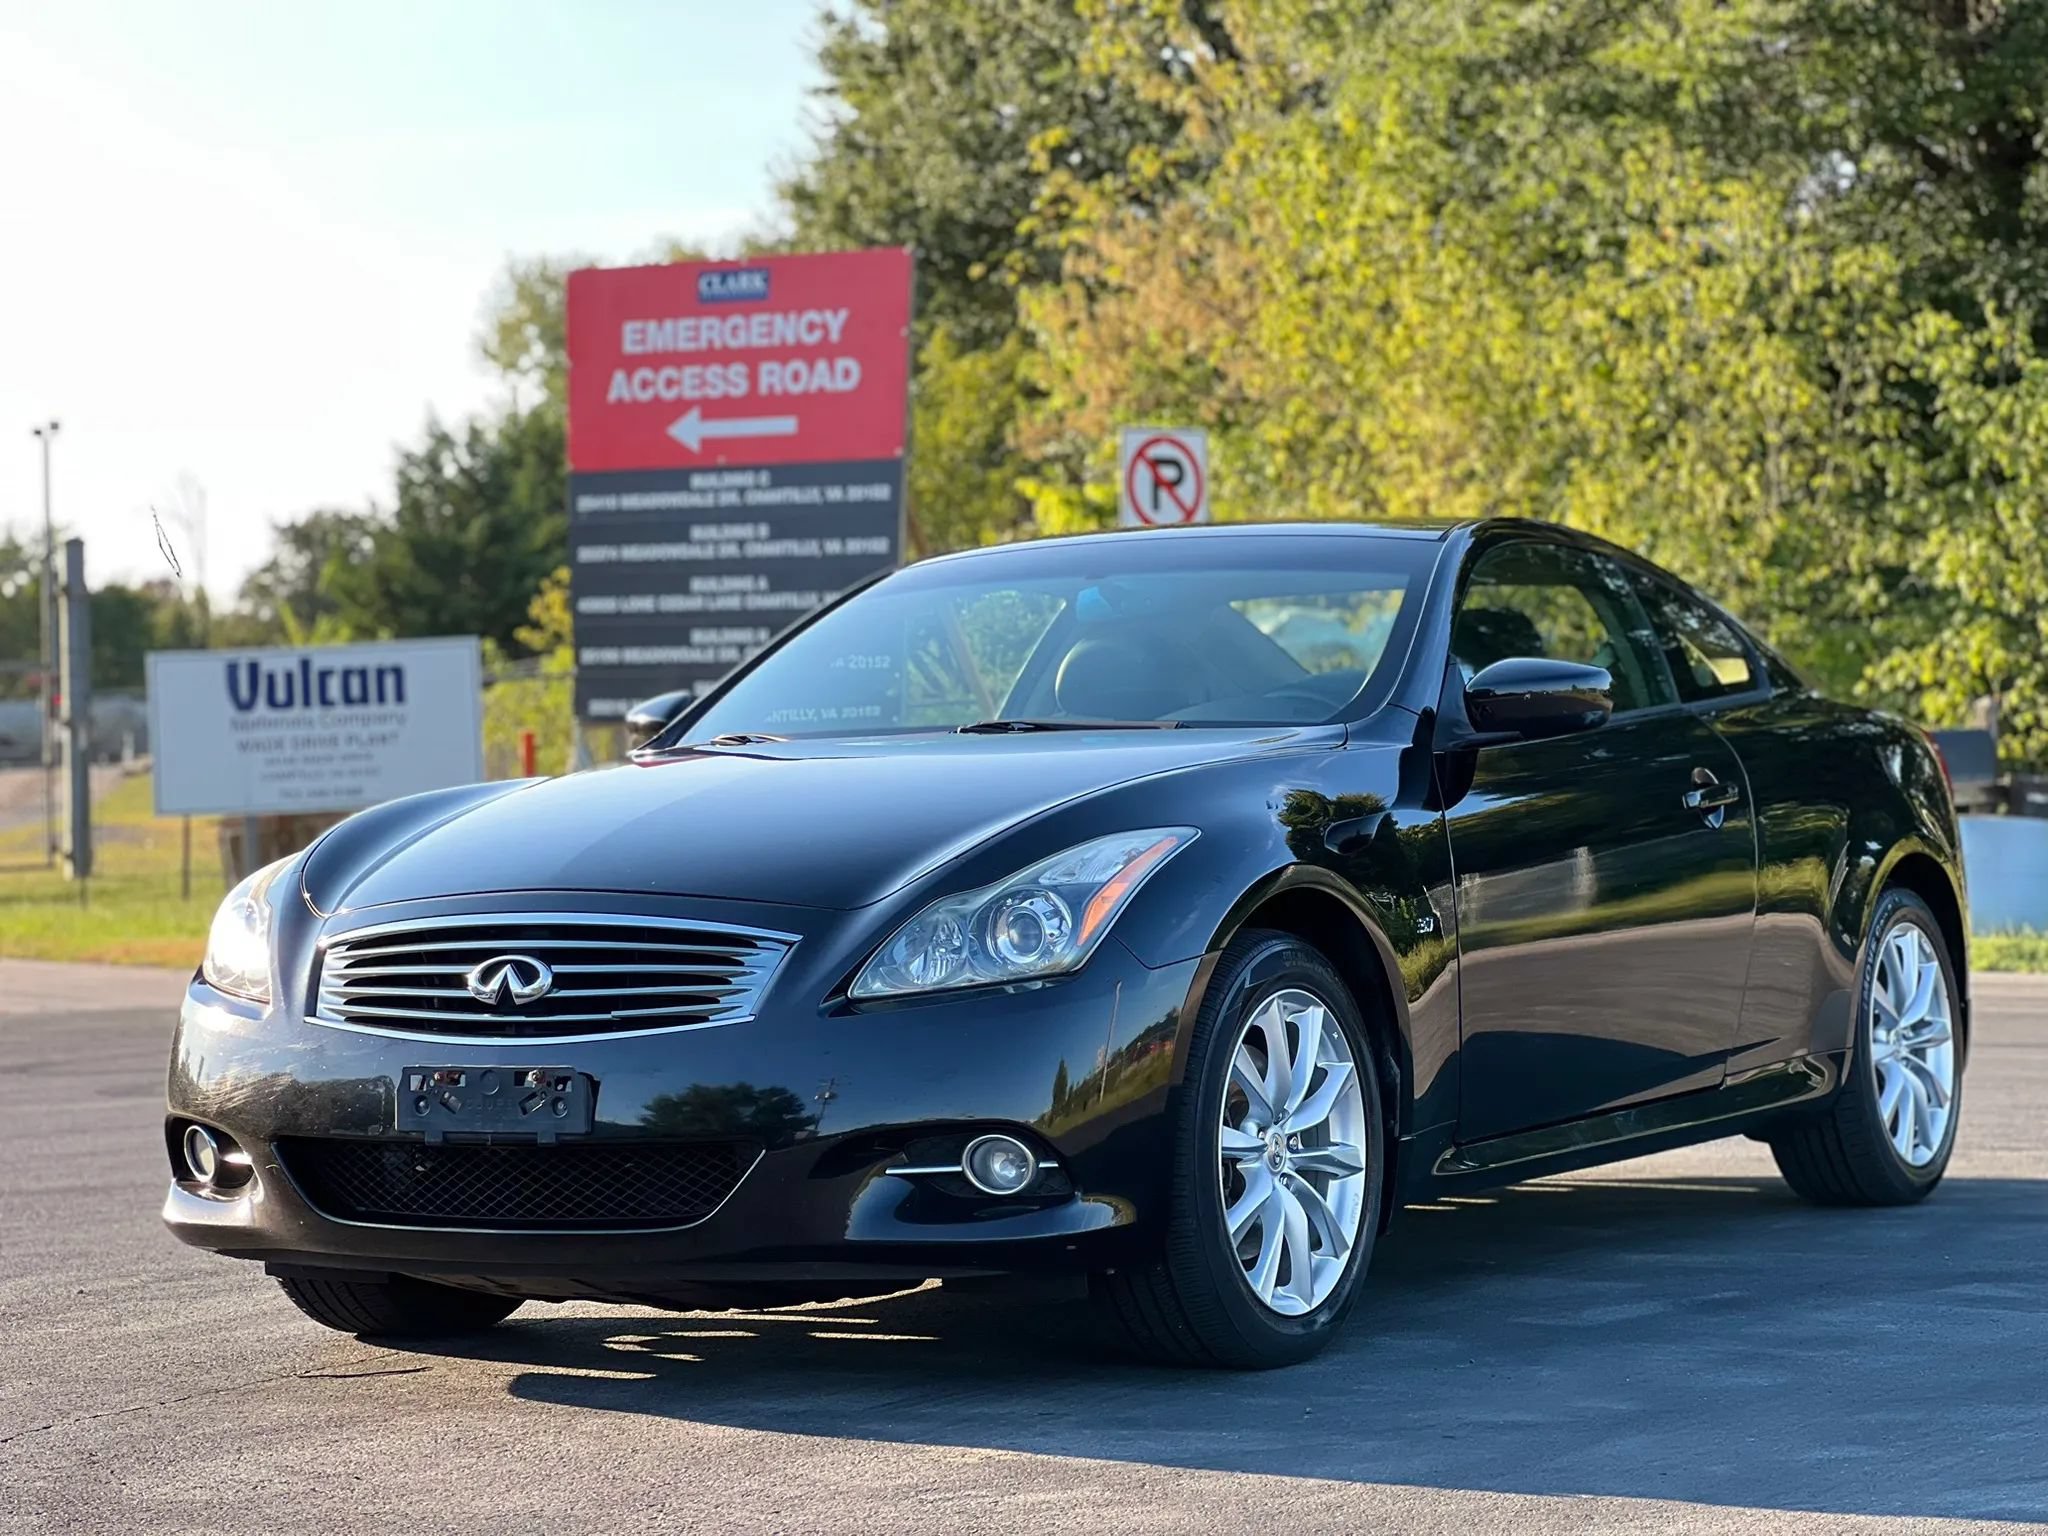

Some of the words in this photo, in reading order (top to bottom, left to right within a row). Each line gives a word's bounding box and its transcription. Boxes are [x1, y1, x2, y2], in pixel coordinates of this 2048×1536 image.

[621, 309, 850, 355] EMERGENCY
[606, 362, 749, 404] ACCESS
[758, 357, 861, 397] ROAD
[848, 654, 891, 669] 20152
[226, 657, 406, 713] Vulcan
